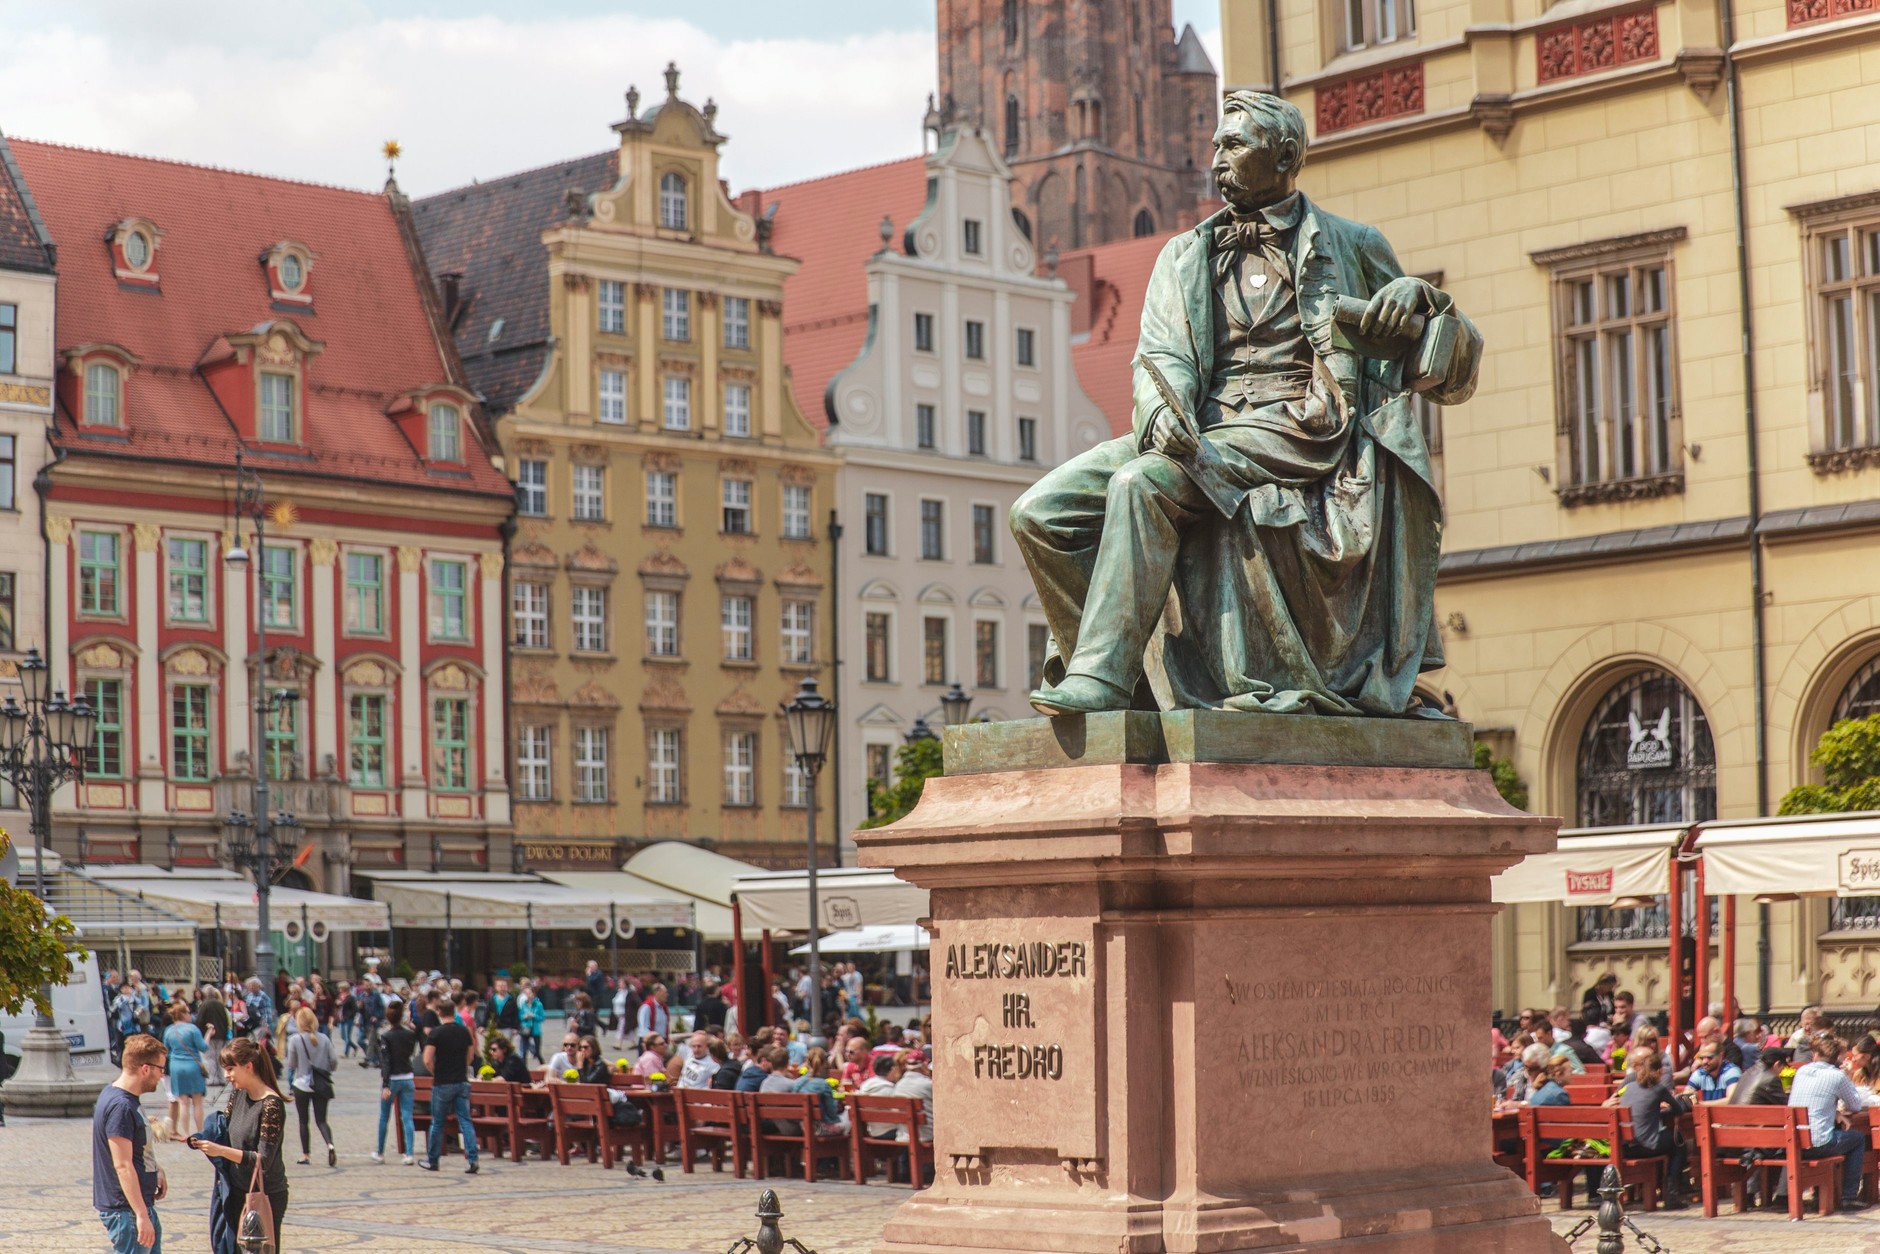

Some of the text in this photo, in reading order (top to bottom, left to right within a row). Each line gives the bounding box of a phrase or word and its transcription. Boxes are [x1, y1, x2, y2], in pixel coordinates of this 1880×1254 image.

[1639, 740, 1660, 752] POD
[568, 845, 612, 862] POLSKI
[1568, 872, 1611, 891] TYSKIE
[945, 941, 1086, 979] ALEKSANDER
[1002, 992, 1036, 1029] HR.
[1237, 1023, 1457, 1062] ALEKSANDRA FREDRY
[974, 1042, 1063, 1081] FREDRO
[1239, 1065, 1338, 1089] WZNIESIONO
[1343, 1063, 1363, 1081] WE
[1303, 1090, 1316, 1108] 15
[1319, 1087, 1362, 1107] LIPCA
